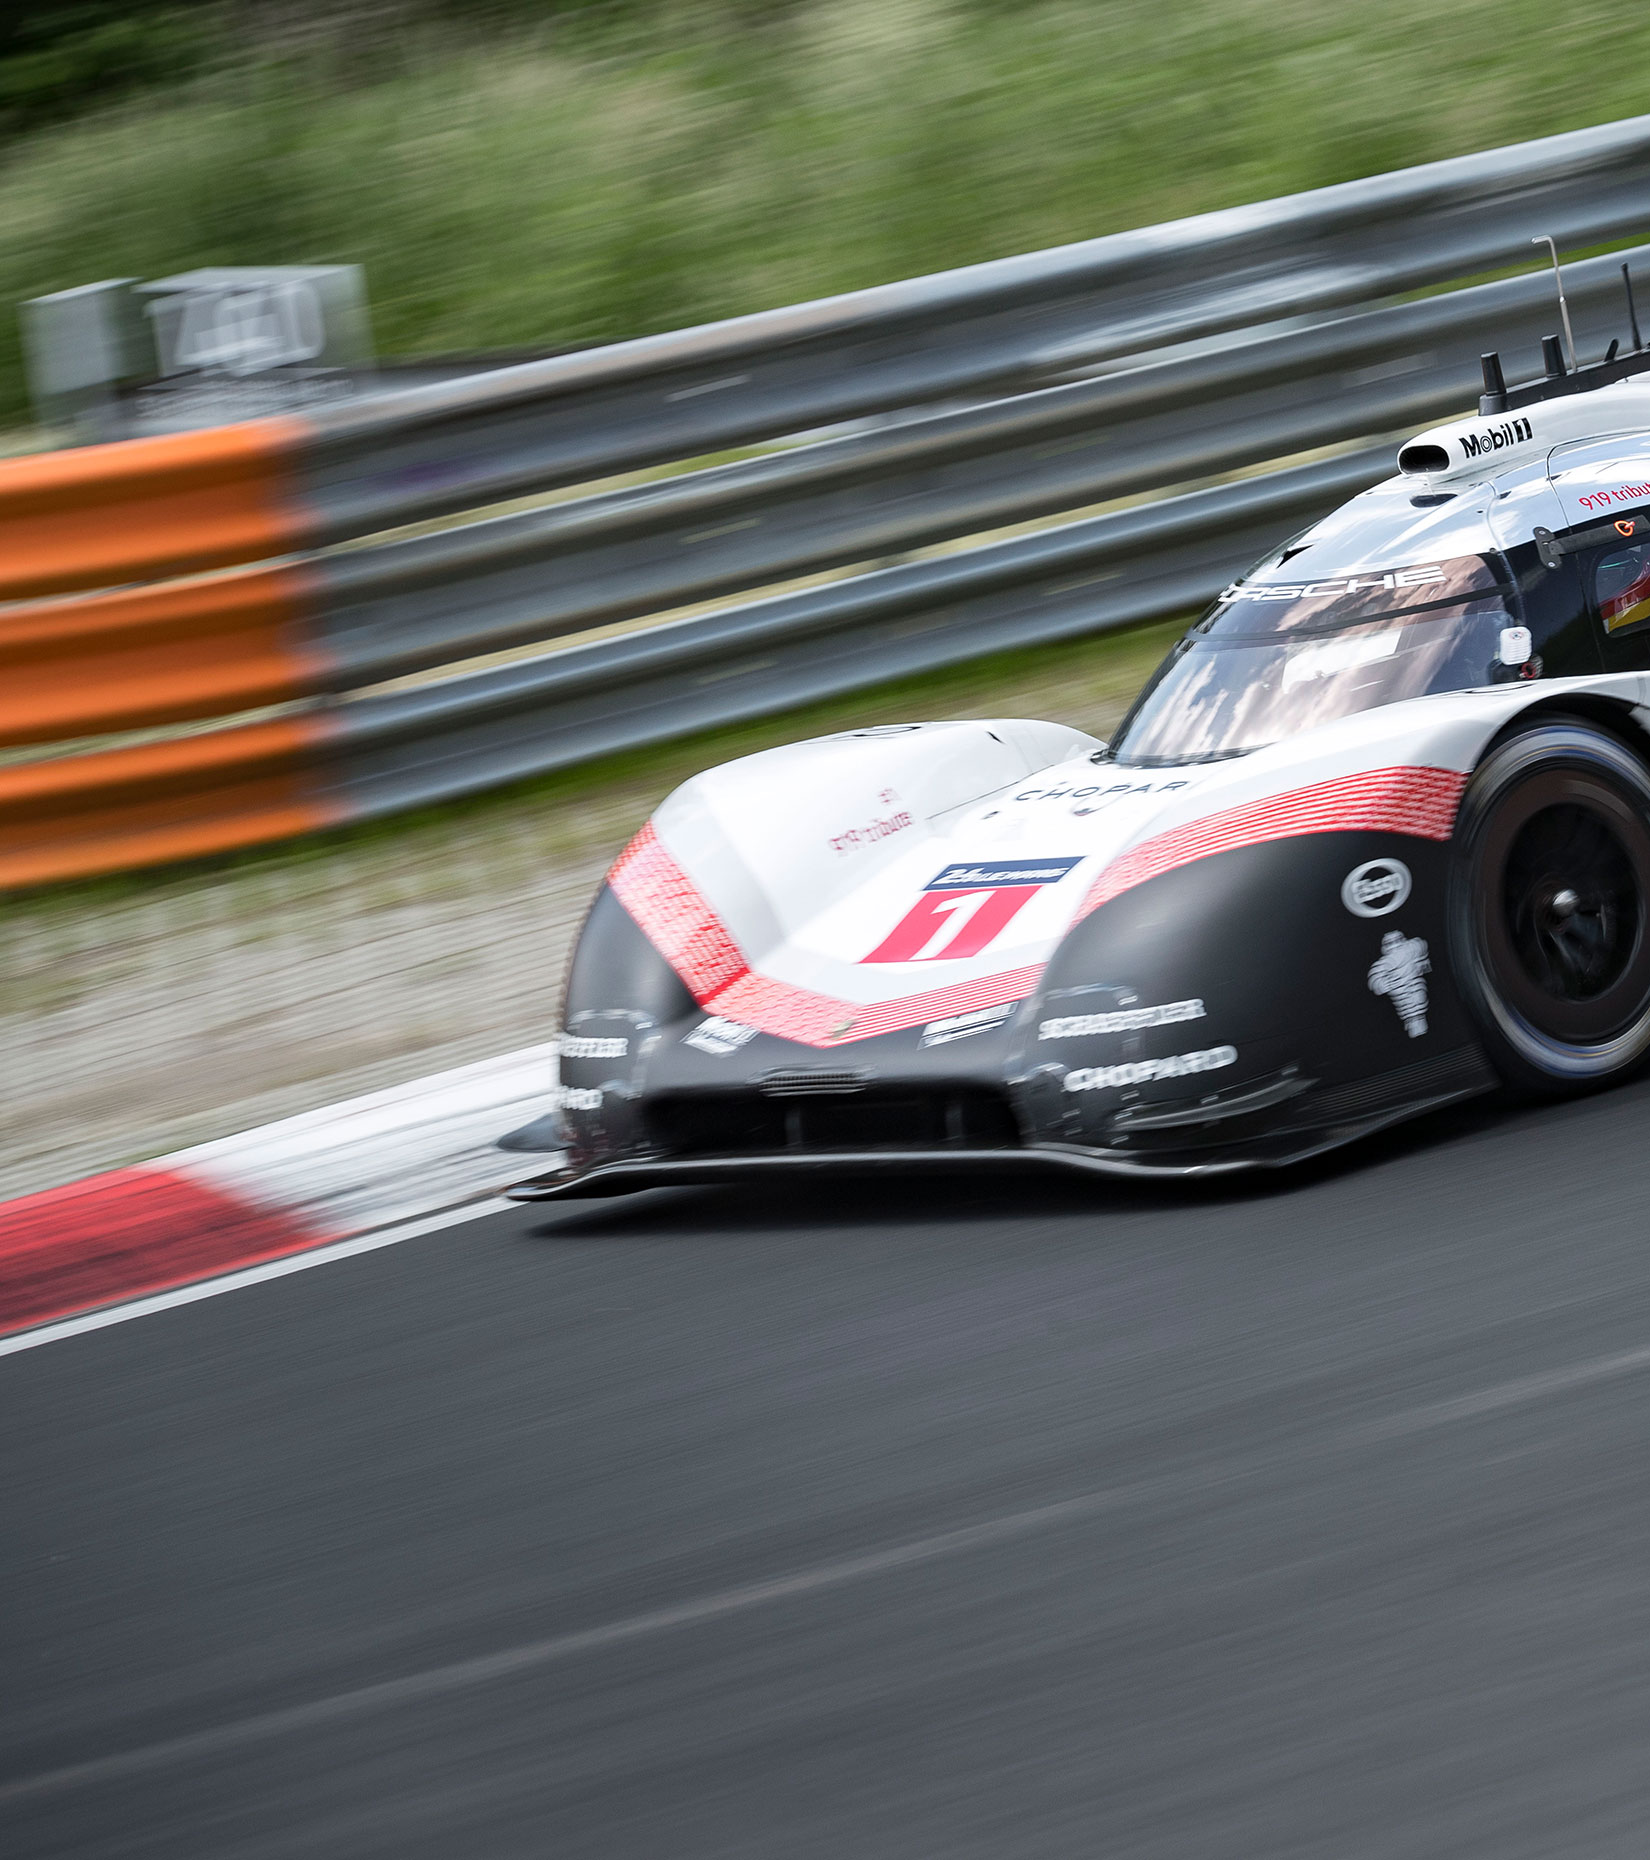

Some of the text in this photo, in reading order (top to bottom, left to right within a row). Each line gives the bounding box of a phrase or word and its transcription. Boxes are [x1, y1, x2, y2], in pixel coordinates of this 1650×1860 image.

[1459, 422, 1515, 458] Mobil
[1578, 491, 1612, 511] 919
[1015, 781, 1191, 801] CHOPAR
[907, 890, 998, 961] 1
